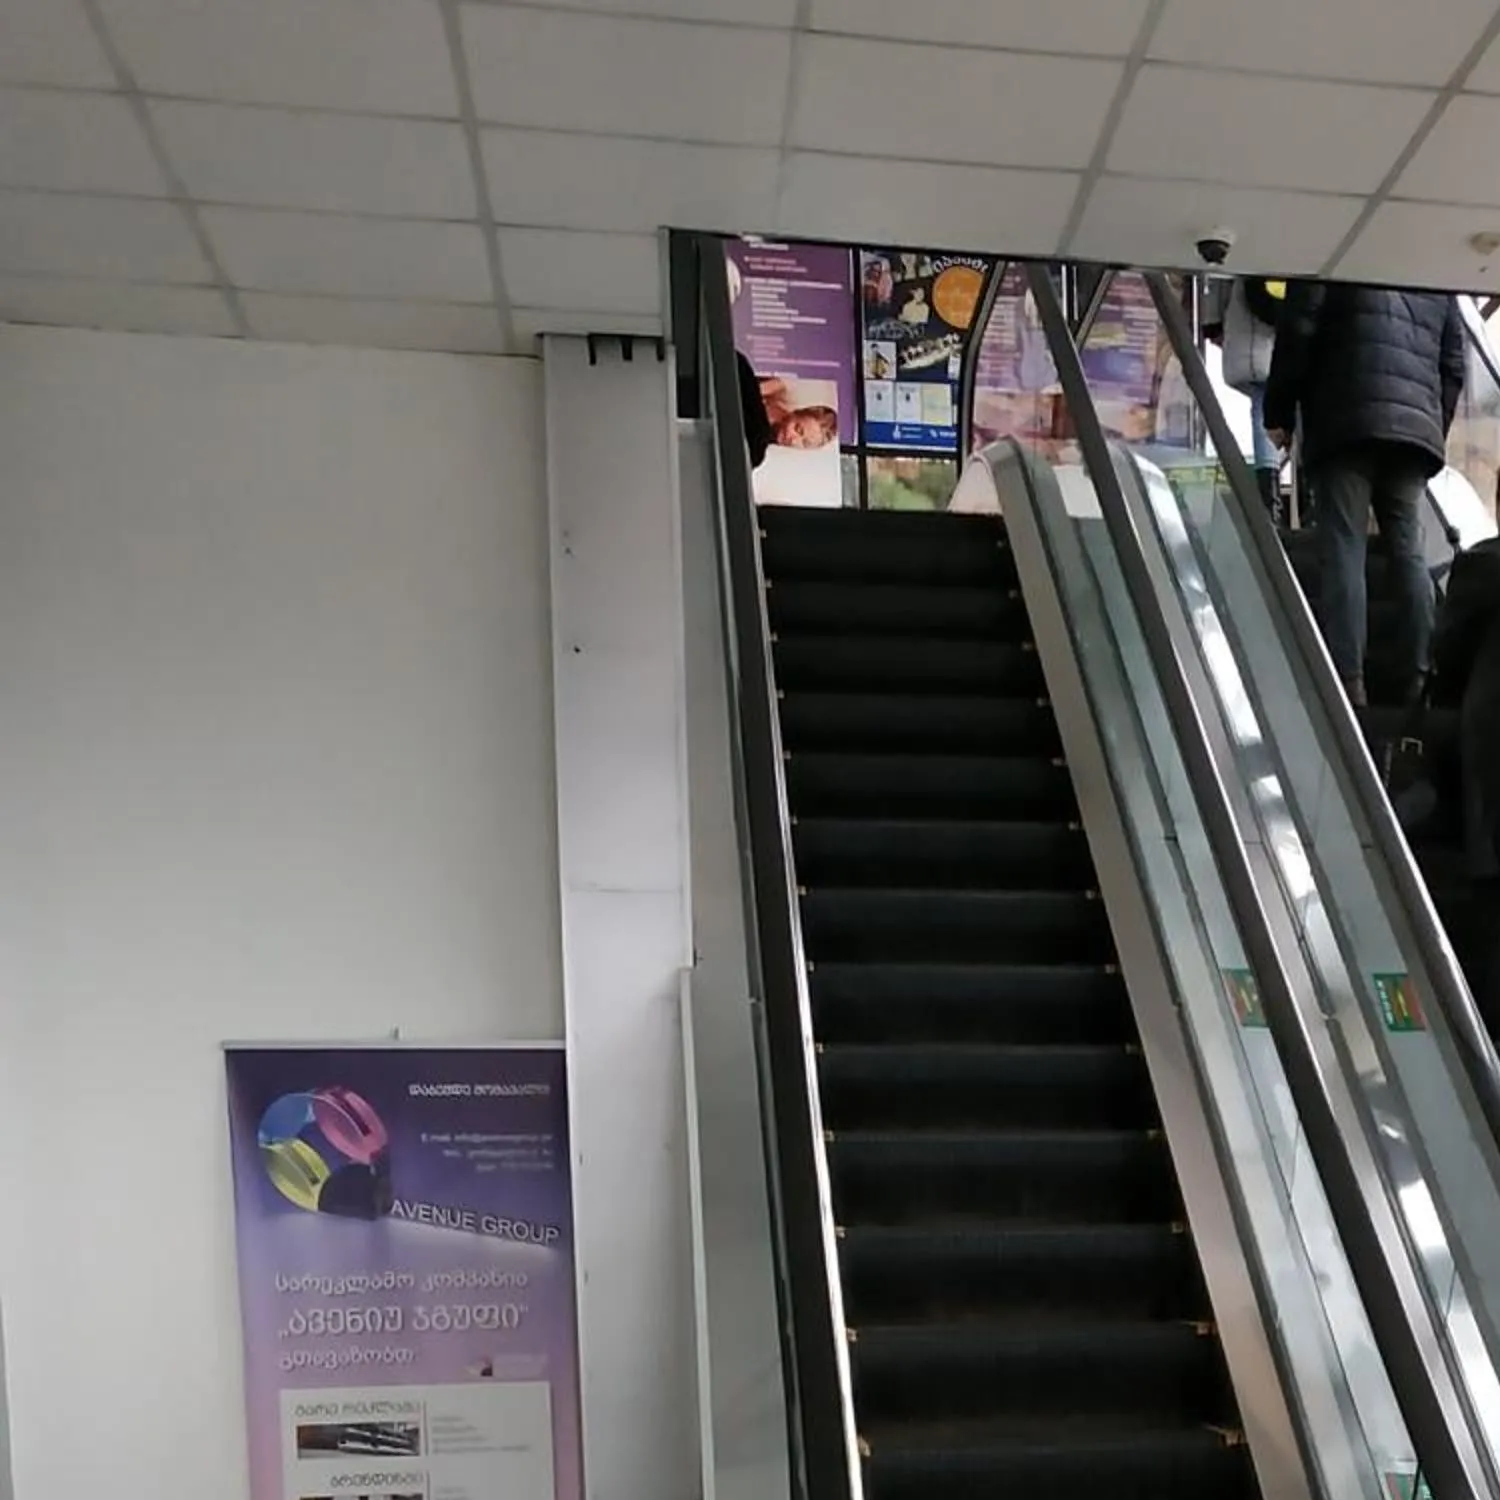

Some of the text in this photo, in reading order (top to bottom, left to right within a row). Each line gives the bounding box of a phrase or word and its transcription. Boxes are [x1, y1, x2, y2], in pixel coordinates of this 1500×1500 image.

[390, 1199, 560, 1246] AVENUE GROUP
[274, 1270, 528, 1296] სარეკლამო კომპანია
